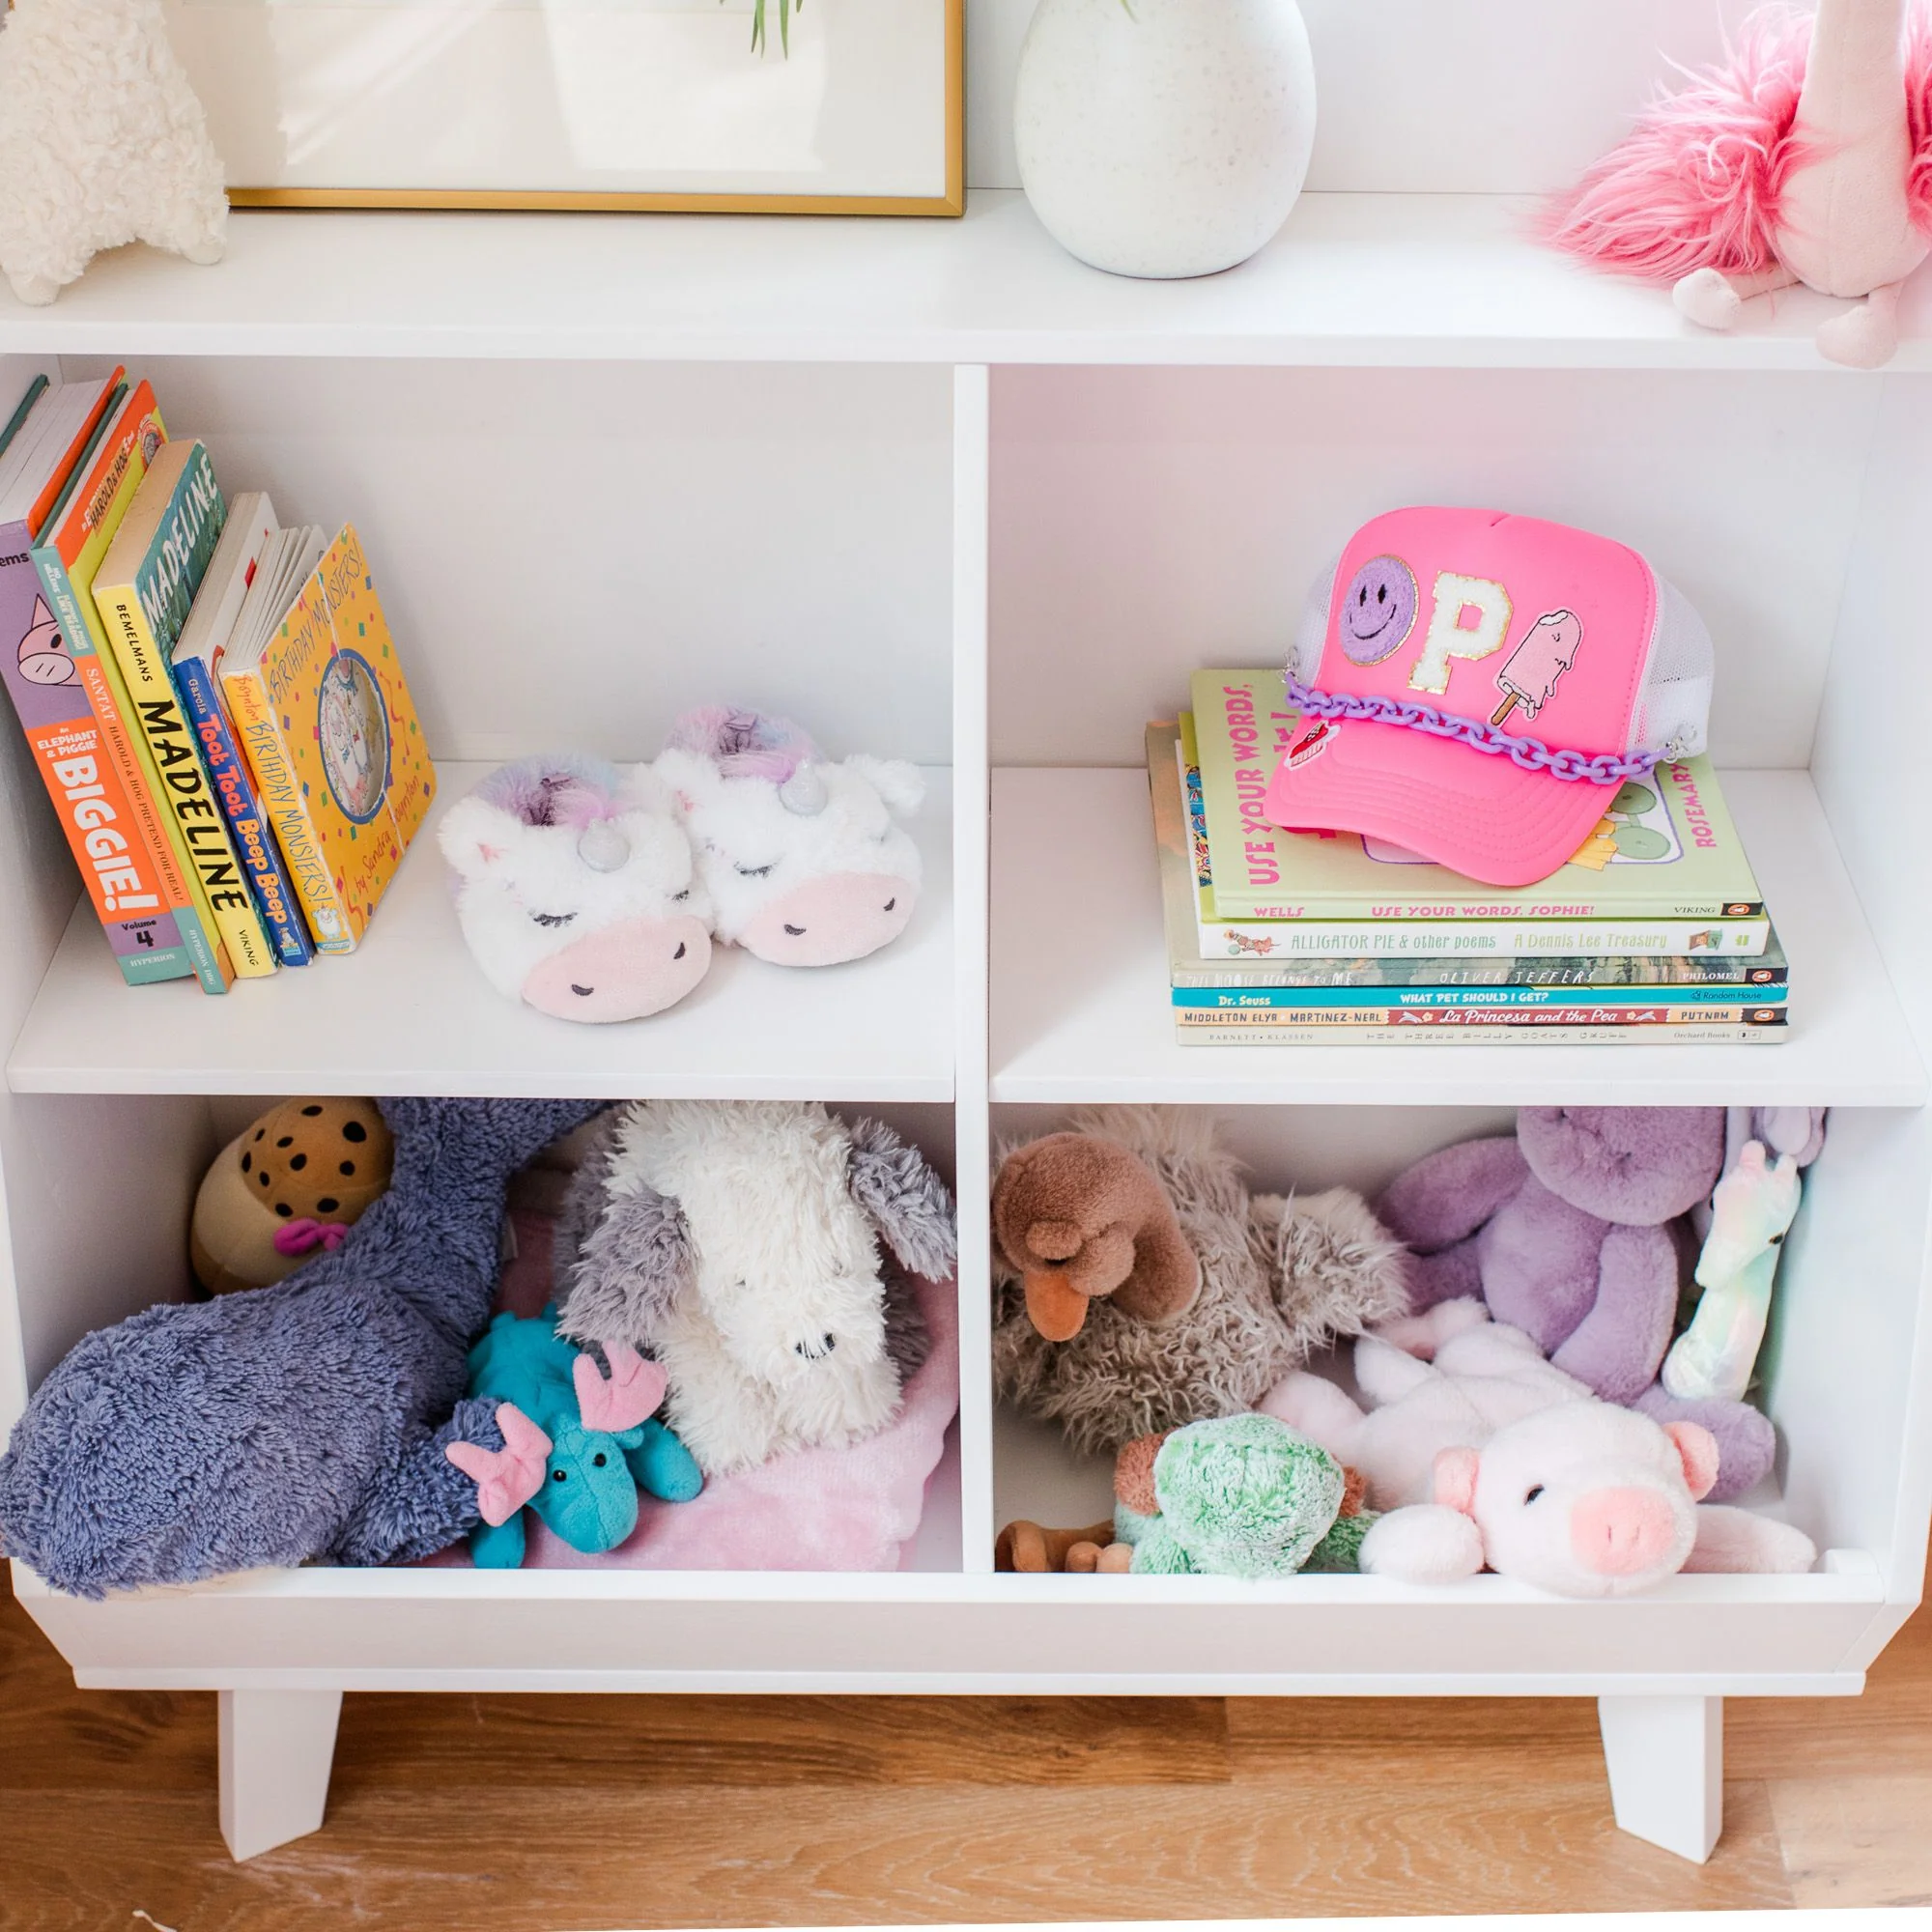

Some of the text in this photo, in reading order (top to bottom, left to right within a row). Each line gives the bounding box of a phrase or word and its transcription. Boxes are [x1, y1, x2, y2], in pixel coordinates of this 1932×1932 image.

[142, 453, 217, 627] MADELINE
[270, 619, 316, 704] BIRTHDAY
[312, 537, 363, 638] MONSTERS!
[1406, 570, 1514, 696] P
[116, 604, 153, 683] BEMELMANS
[37, 729, 98, 751] ELEPHANT
[46, 740, 98, 758] & PIGGIE
[86, 668, 117, 722] SANTAT
[109, 726, 131, 768] HAROLD
[129, 780, 144, 800] HOG
[139, 803, 163, 849] PRETEND
[156, 850, 170, 872] FOR
[165, 872, 185, 901] REAL!
[234, 674, 333, 902] Boynton BIRTHDAY MONSTERS!
[188, 678, 287, 924] Garcia Toot Toot Beep Beep
[1235, 768, 1273, 835] YOUR
[1669, 763, 1717, 847] ROSEMARY
[52, 754, 159, 912] BIGGIE!
[137, 699, 259, 966] MADELINE VIKING
[354, 876, 369, 896] by
[362, 830, 392, 879] Sandra
[1244, 841, 1281, 885] USE
[1253, 906, 1305, 918] WELLS
[1372, 906, 1403, 917] USE
[1408, 906, 1456, 917] YOUR
[1528, 905, 1596, 916] SOPHIE!
[122, 919, 156, 931] Volume
[136, 930, 154, 947] 4
[1291, 934, 1496, 952] ALLIGATOR PIE & other poems
[1515, 933, 1667, 949] A Dennis Lee Treasury
[129, 952, 176, 967] HYPERION
[1439, 969, 1595, 984] OLIVER JEFFERS
[1683, 972, 1740, 980] PHILOMEL
[1218, 995, 1271, 1006] Dr. Seuss
[1401, 992, 1549, 1003] WHAT PET SHOULD I GET?
[1184, 1011, 1381, 1022] MIDDLETON ELYA MARTINEZ-NEAL
[1439, 1009, 1618, 1023] La Princesa and the Pea
[1681, 1011, 1729, 1020] PUTNAM
